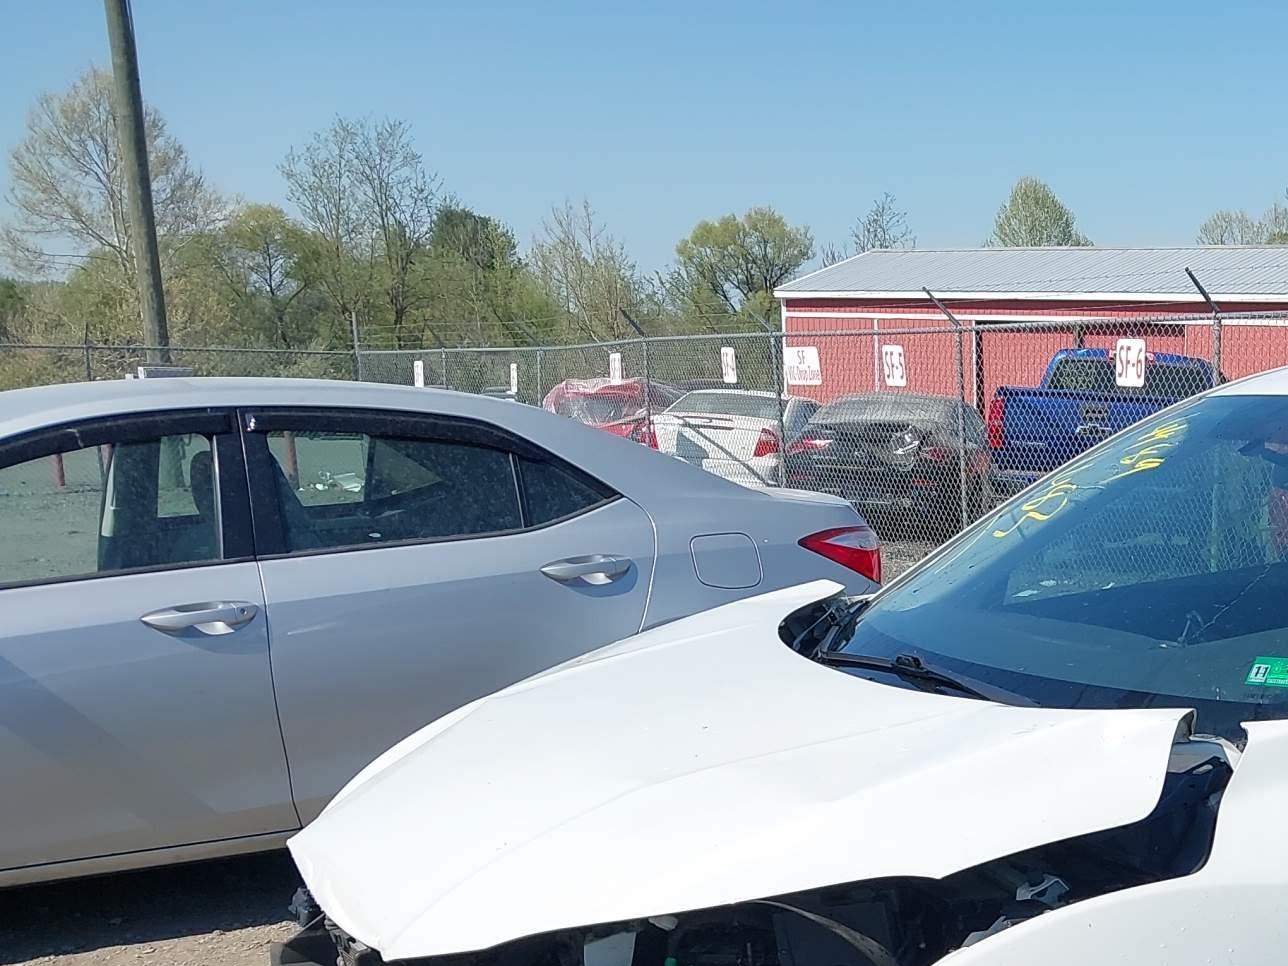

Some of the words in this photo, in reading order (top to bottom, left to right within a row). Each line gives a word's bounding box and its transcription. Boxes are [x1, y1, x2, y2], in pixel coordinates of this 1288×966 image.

[796, 350, 806, 365] SF
[884, 351, 905, 380] SF-5
[1118, 345, 1143, 378] SF-6
